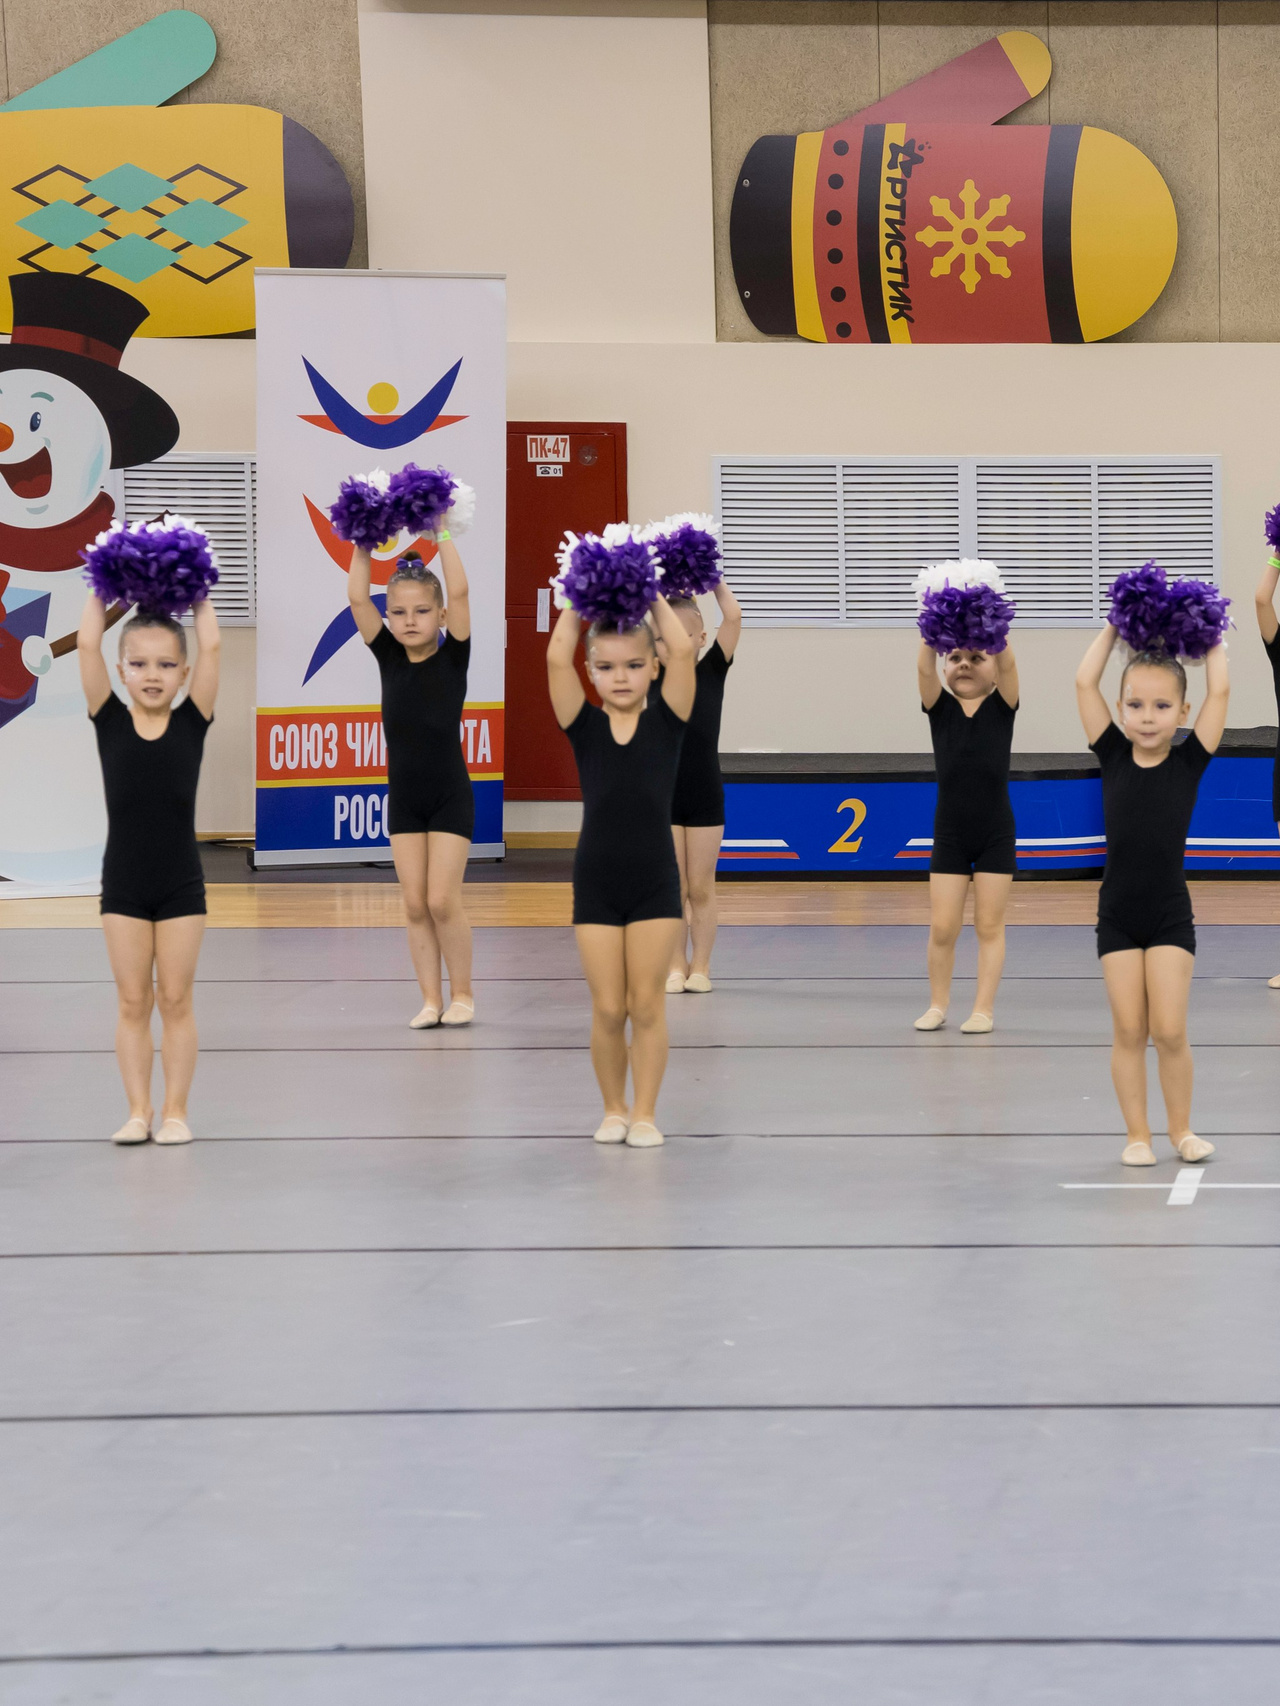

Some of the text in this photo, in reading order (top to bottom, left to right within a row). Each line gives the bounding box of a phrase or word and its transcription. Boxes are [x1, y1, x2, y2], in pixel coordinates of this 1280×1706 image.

[529, 437, 568, 458] ПК-47
[553, 467, 562, 475] 01
[269, 723, 338, 770] СОЮЗ
[827, 797, 867, 853] 2
